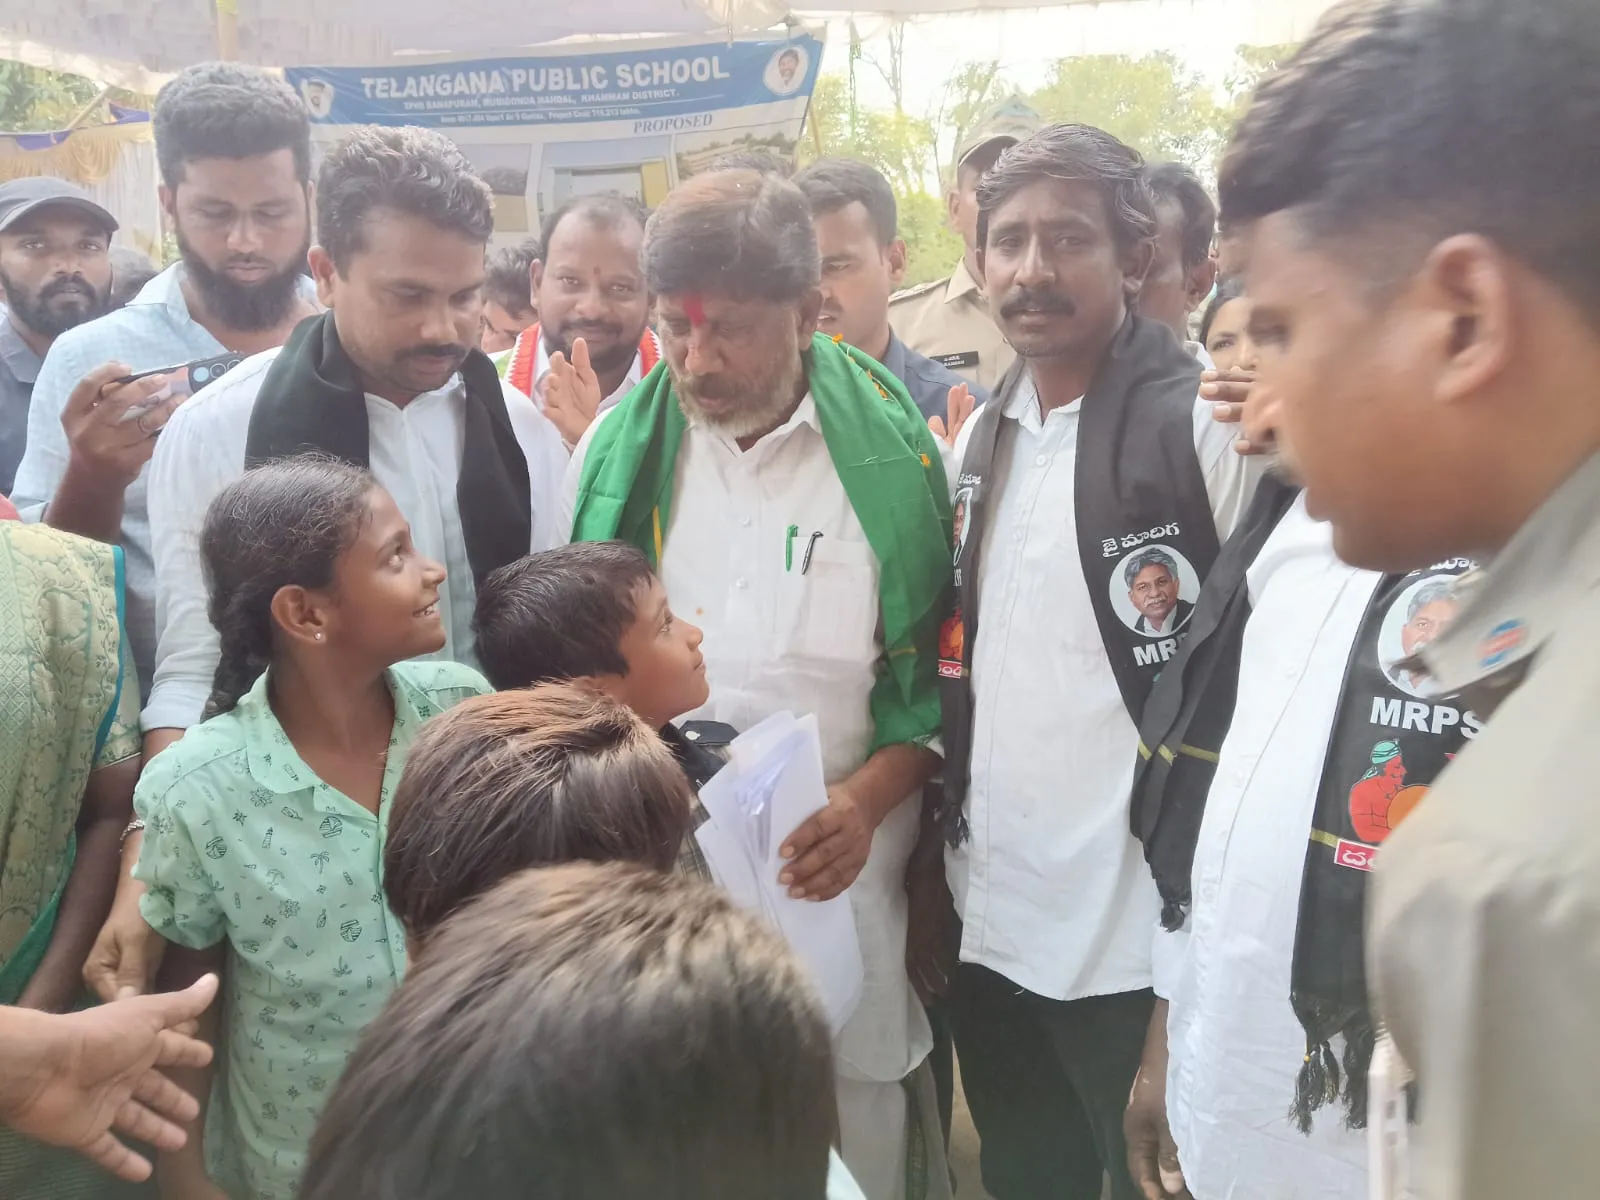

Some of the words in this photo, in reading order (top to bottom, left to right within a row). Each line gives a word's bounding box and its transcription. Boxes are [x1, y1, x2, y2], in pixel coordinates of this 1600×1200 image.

[361, 71, 504, 98] TELANGANA
[511, 66, 609, 93] PUBLIC
[615, 56, 730, 88] SCHOOL
[632, 89, 680, 100] DISTRICT.
[633, 114, 713, 134] PROPOSED
[1101, 538, 1120, 557] జై
[1121, 522, 1180, 548] మాదిగ
[1369, 696, 1487, 741] MRPS
